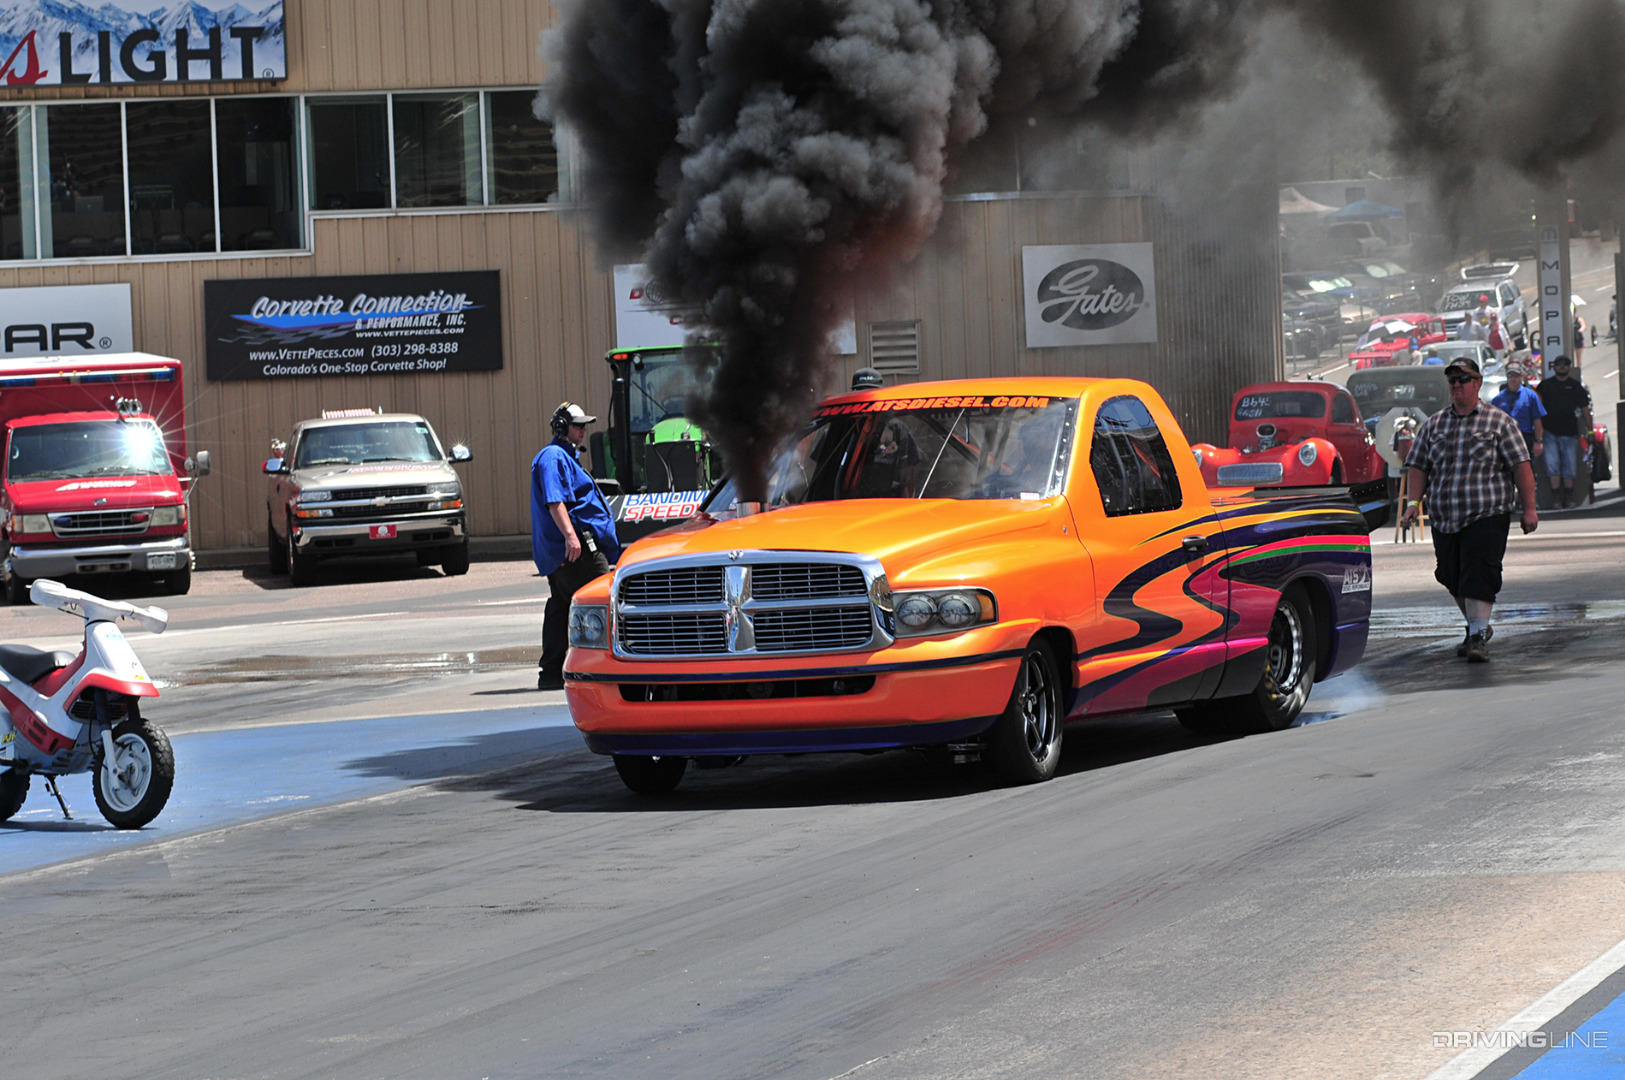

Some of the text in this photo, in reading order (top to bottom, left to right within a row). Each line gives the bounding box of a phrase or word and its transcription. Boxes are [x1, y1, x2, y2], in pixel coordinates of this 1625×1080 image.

[59, 26, 265, 84] LIGHT
[1040, 265, 1140, 323] Gates
[252, 289, 473, 318] Corvette Connection
[355, 313, 467, 329] & PERFORMANCE, INC.
[355, 328, 464, 339] WWW.VETTEPIECES.COM
[371, 345, 402, 358] (303)
[404, 342, 459, 356] 298-8388
[263, 358, 447, 376] Colorado's One-Stop Corvette Shop!
[625, 503, 700, 520] SPEED
